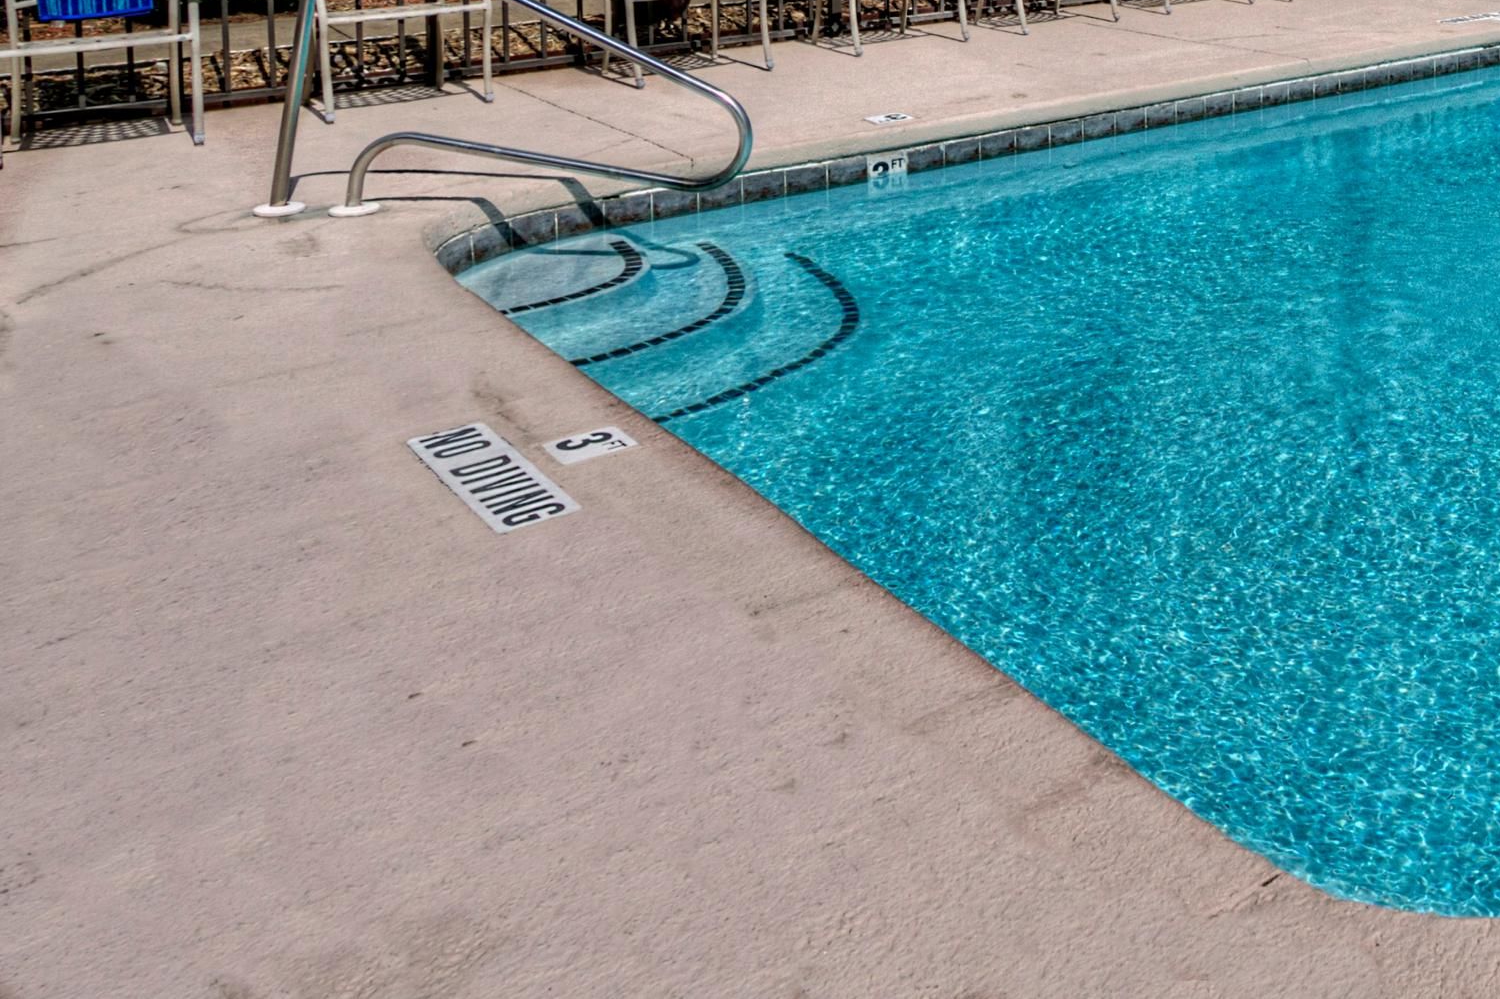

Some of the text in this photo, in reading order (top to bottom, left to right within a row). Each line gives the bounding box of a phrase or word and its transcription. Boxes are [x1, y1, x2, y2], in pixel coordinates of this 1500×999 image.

[891, 158, 904, 170] FT
[555, 431, 613, 451] 3
[419, 427, 566, 527] NO DIVING
